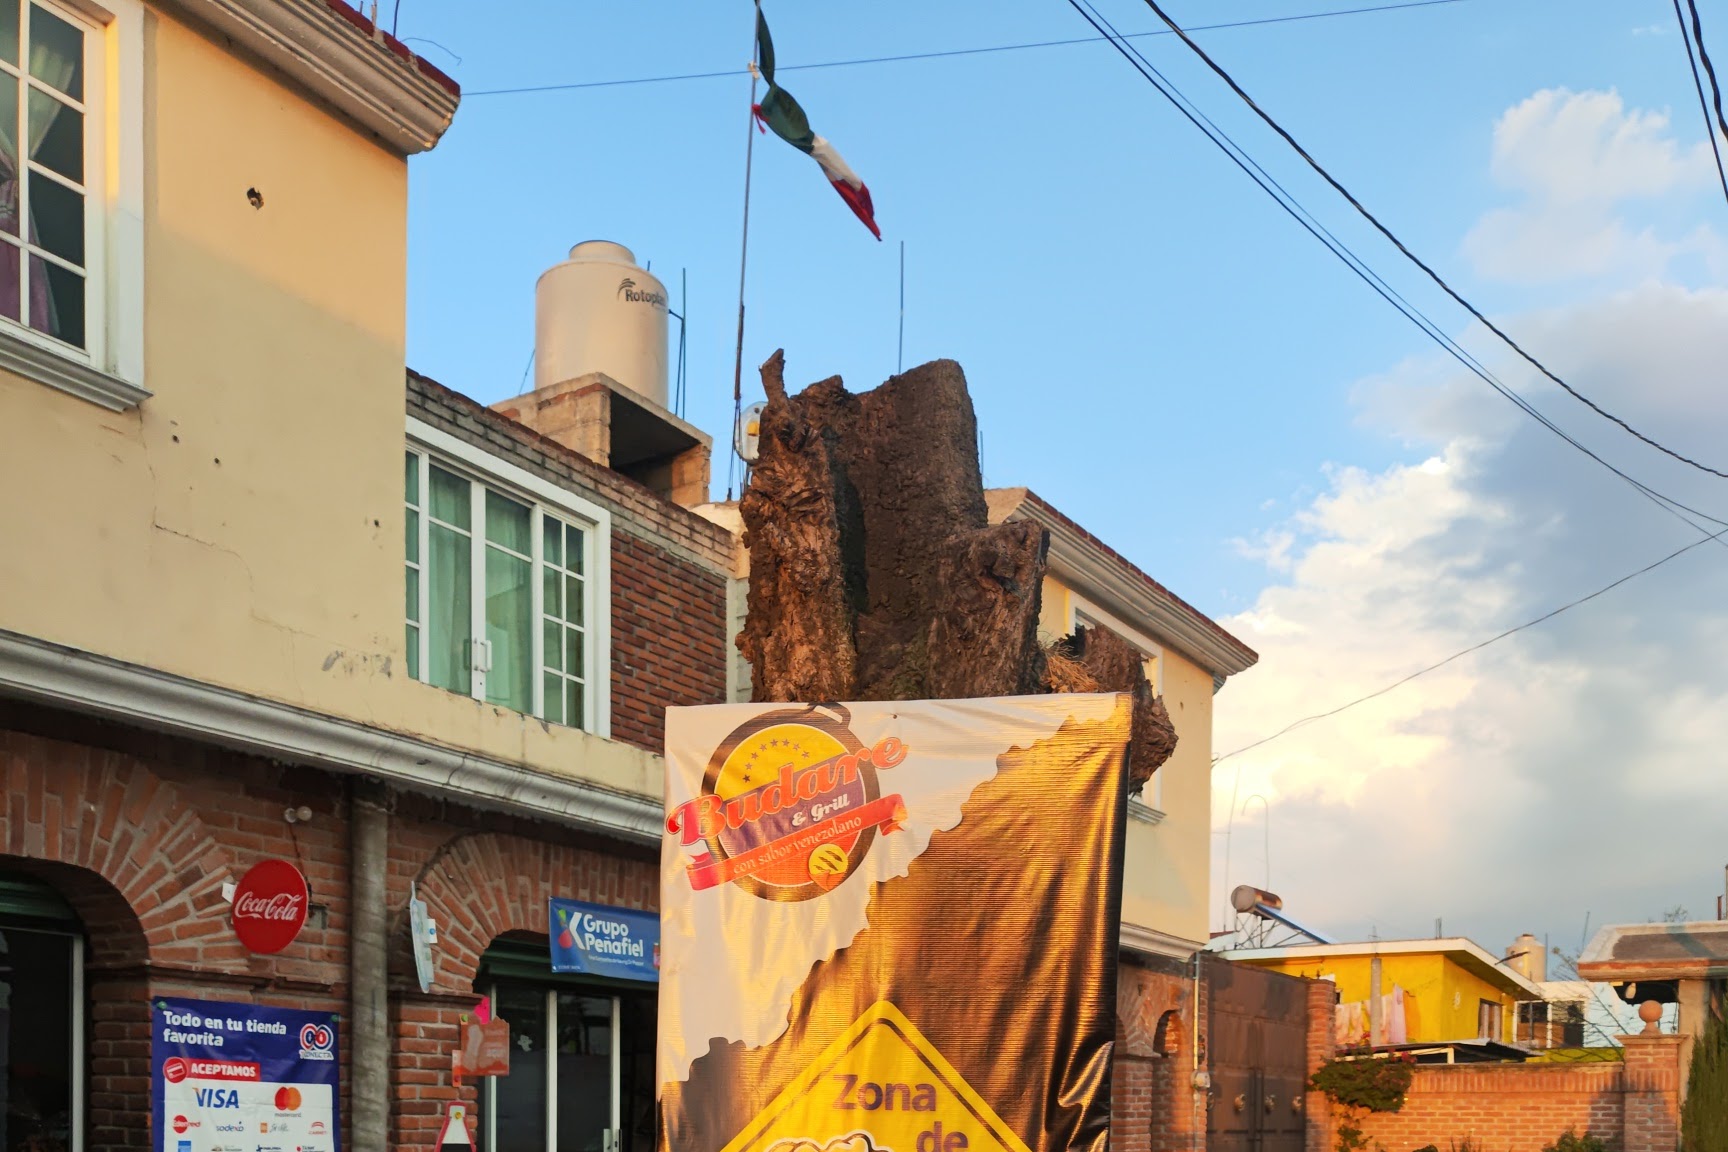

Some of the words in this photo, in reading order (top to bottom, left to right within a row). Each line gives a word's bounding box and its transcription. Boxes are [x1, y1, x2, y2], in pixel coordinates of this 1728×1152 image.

[665, 736, 910, 846] Budare
[790, 811, 806, 827] &
[810, 793, 850, 822] Grill
[733, 859, 757, 875] con
[758, 842, 794, 867] sabor
[793, 816, 862, 853] venezolano
[234, 891, 303, 920] Coca-Cola
[583, 914, 629, 939] Grupo
[584, 932, 644, 957] Peñafiel
[163, 1011, 201, 1027] Todo
[205, 1017, 223, 1030] en
[227, 1018, 242, 1031] tu
[246, 1019, 287, 1035] tienda
[163, 1029, 224, 1047] favorita
[191, 1063, 256, 1078] ACEPTAMOS
[192, 1087, 240, 1109] VISA
[833, 1073, 937, 1113] Zona
